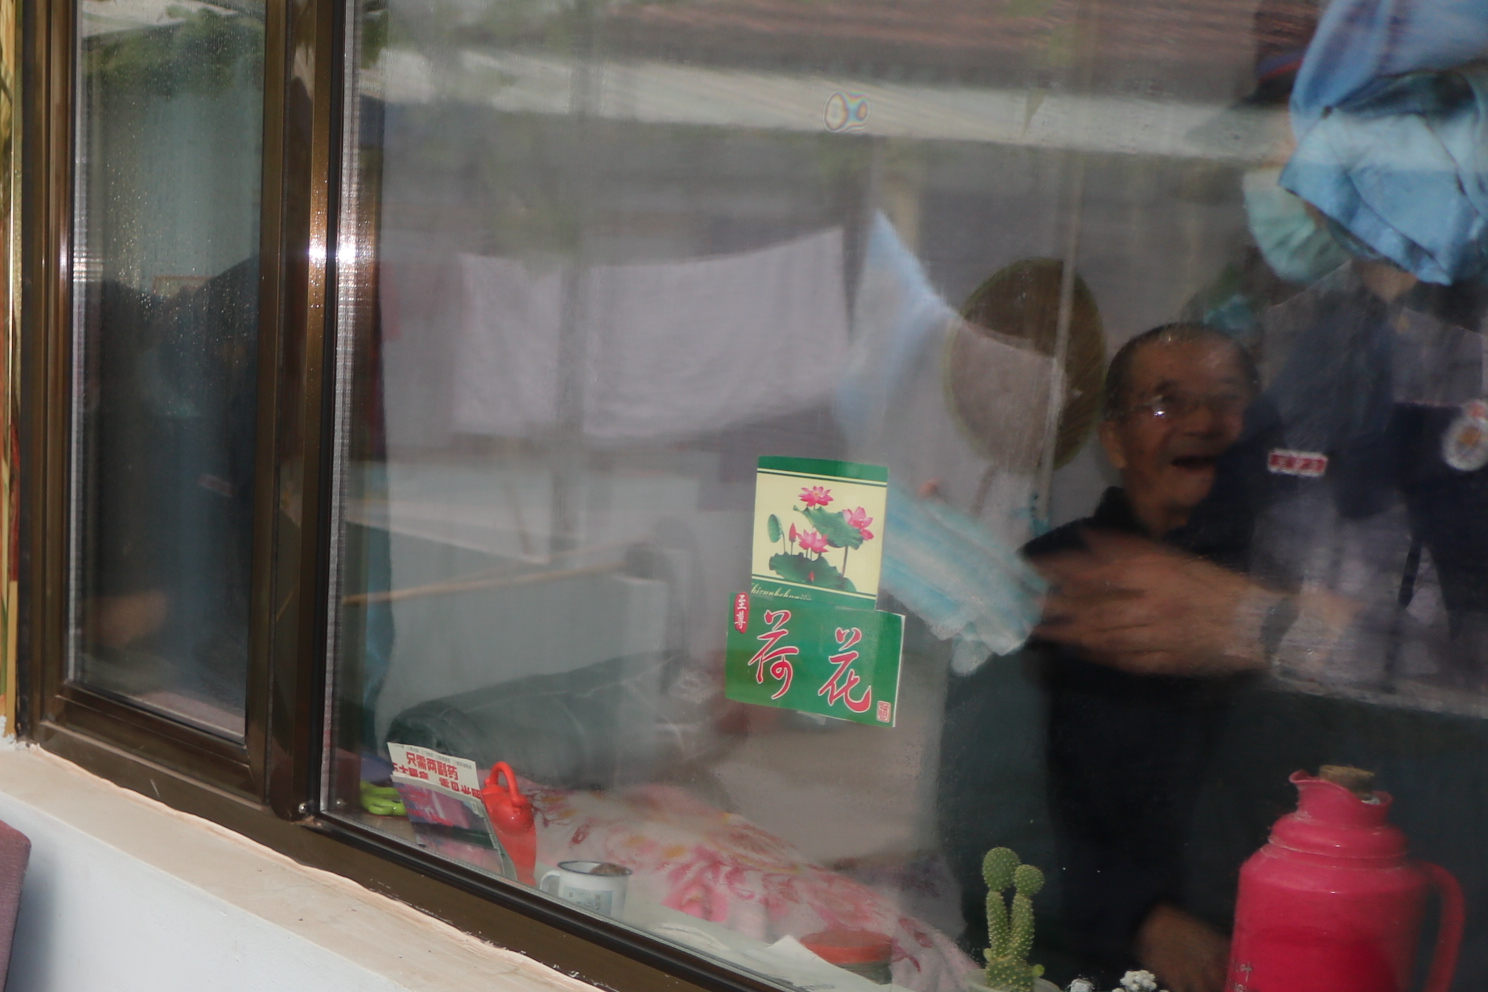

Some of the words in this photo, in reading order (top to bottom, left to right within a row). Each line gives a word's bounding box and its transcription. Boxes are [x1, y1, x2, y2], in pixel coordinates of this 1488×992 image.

[748, 609, 872, 713] 荷花
[406, 752, 459, 780] 只需两副药
